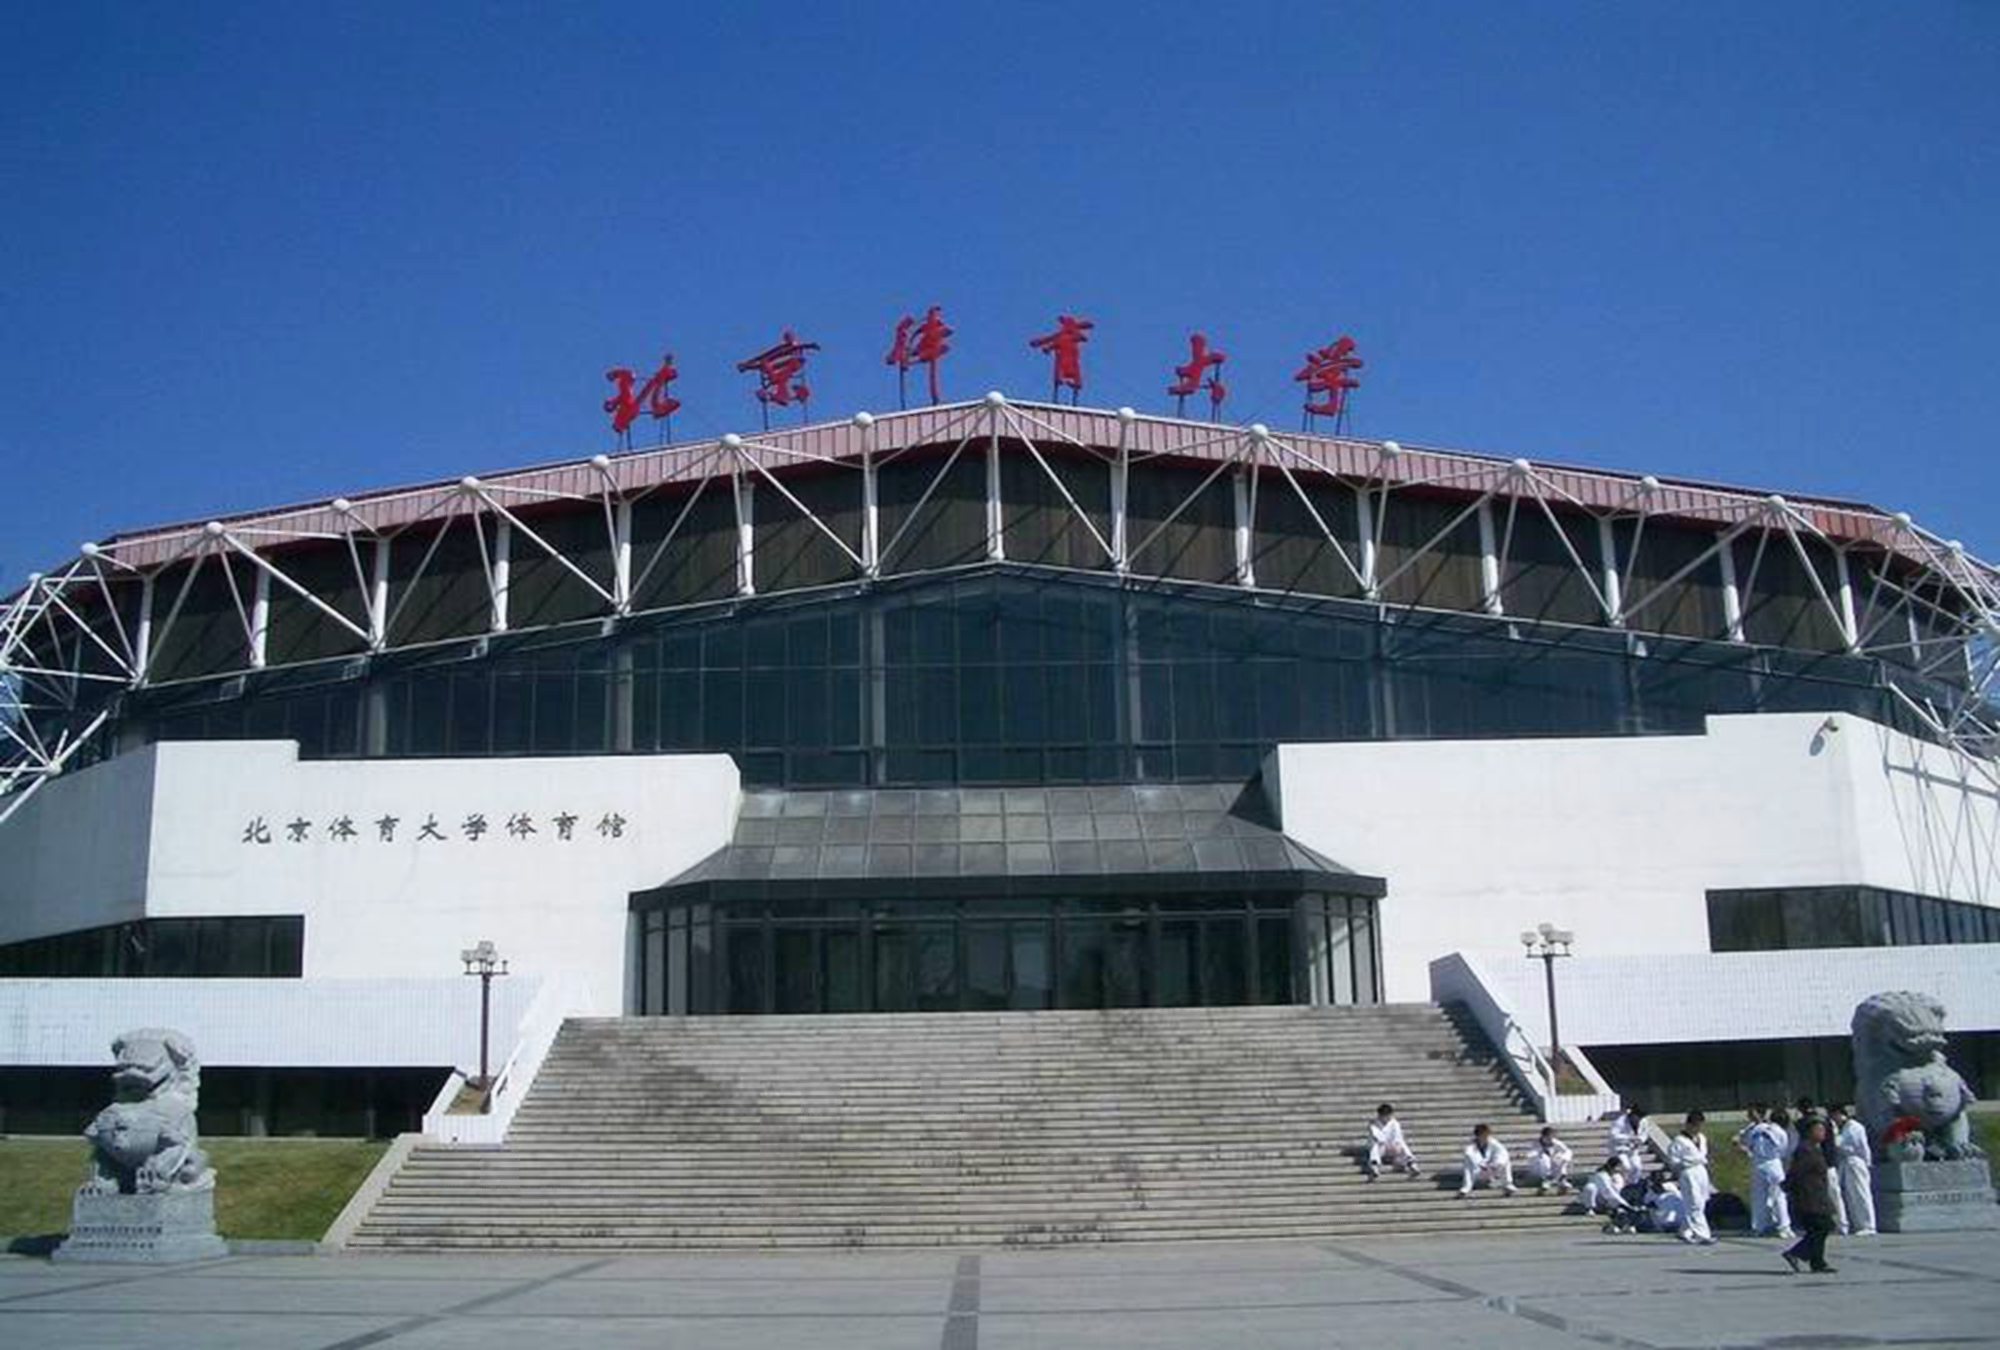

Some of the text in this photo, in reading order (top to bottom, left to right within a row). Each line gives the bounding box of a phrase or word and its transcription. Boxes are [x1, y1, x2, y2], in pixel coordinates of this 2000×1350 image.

[604, 305, 1364, 434] 北京体育大学
[241, 811, 628, 844] 北京体育大学体育馆
